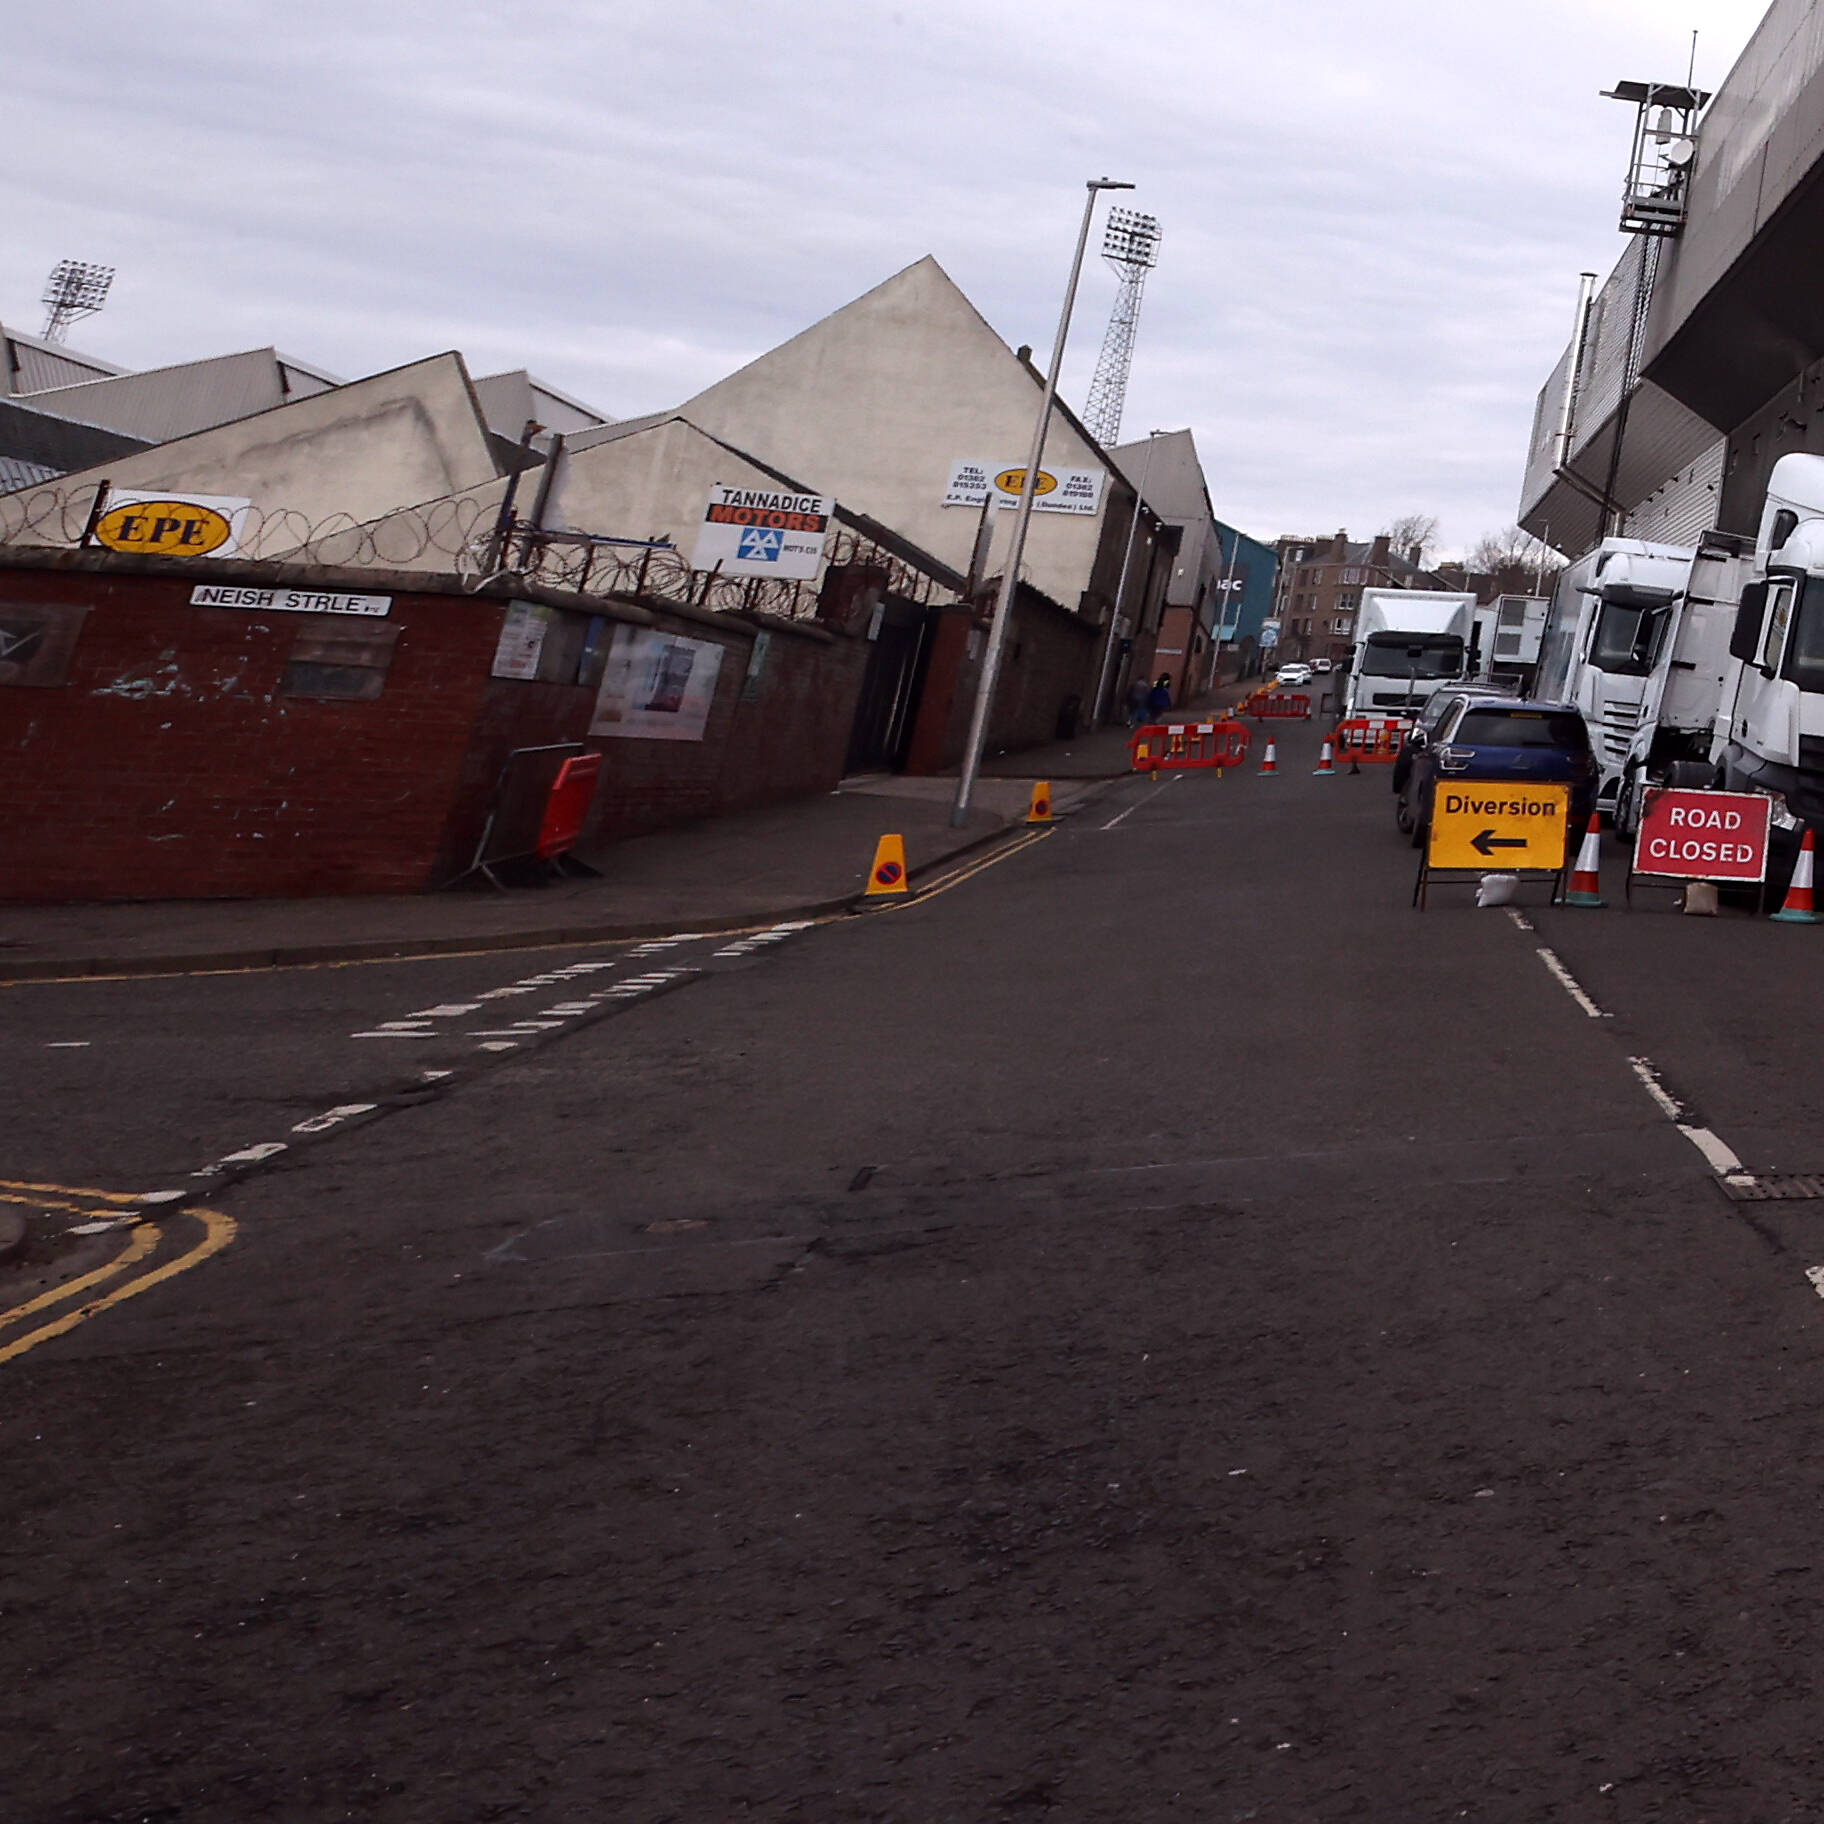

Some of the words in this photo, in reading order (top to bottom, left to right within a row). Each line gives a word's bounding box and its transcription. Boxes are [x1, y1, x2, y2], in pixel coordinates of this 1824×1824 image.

[722, 489, 822, 513] TANNADICE
[709, 504, 821, 532] MOTORS
[116, 515, 210, 546] EPE
[200, 587, 275, 607] NEISH
[1445, 794, 1556, 816] Diversion
[1668, 807, 1742, 830] ROAD
[1649, 838, 1754, 864] CLOSED
